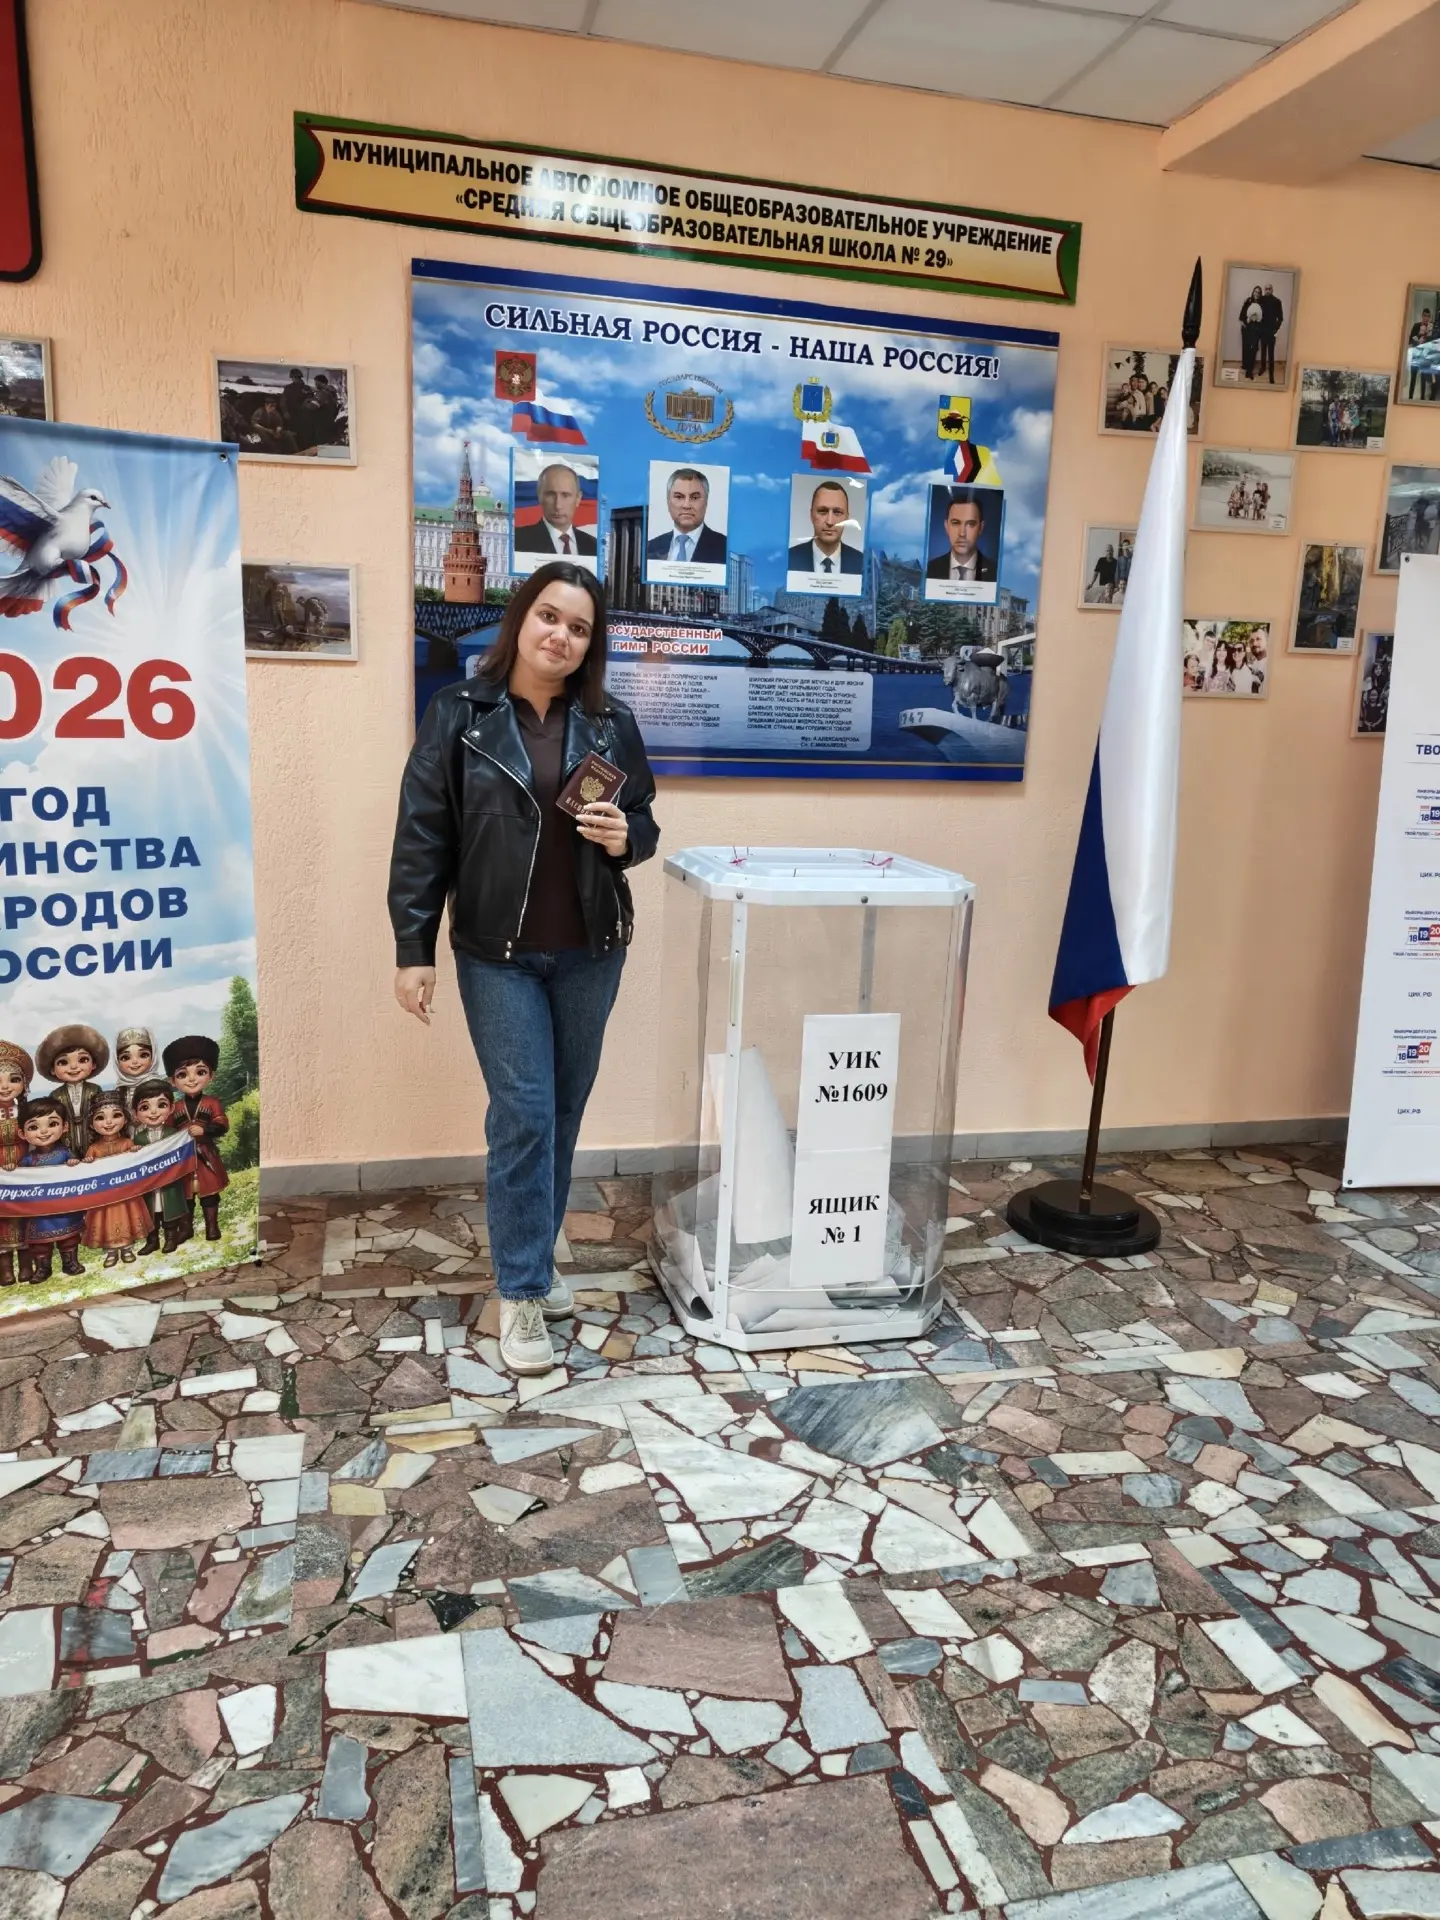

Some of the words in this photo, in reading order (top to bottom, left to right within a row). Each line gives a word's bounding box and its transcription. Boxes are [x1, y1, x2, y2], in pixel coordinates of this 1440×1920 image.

[332, 138, 533, 187] МУНИЦИПАЛЬНОЕ
[540, 167, 681, 207] АВТОНОМНОЕ
[685, 188, 929, 239] ОБЩЕОБРАЗОВАТЕЛЬНОЕ
[932, 221, 1053, 255] УЧРЕЖДЕНИЕ
[456, 187, 565, 222] «СРЕДНЯЯ
[570, 203, 824, 254] ОБЩЕОБРАЗОВАТЕЛЬНАЯ
[829, 238, 896, 264] ШКОЛА
[901, 245, 920, 264] №
[924, 247, 953, 269] 29»
[484, 303, 633, 341] СИЛЬНАЯ
[642, 320, 762, 354] РОССИЯ
[789, 335, 874, 366] НАША
[883, 346, 1000, 379] РОССИЯ!
[606, 624, 722, 640] ОСУДАРСТВЕННЫЙ
[612, 641, 647, 653] ГИМН
[652, 642, 709, 655] РОССИИ
[1415, 744, 1440, 755] ТВО
[0, 786, 110, 827] ГОД
[1420, 814, 1430, 822] 18
[1431, 809, 1440, 818] 19
[0, 887, 188, 931] РОДОВ
[1409, 934, 1418, 942] 18
[1420, 931, 1429, 939] 19
[1430, 926, 1440, 935] 20
[828, 1050, 881, 1070] УИК
[1398, 1052, 1406, 1061] 18
[1409, 1048, 1417, 1057] 19
[1419, 1045, 1429, 1053] 20
[815, 1082, 888, 1103] №1609
[47, 1179, 98, 1197] народов
[109, 1171, 137, 1186] сила
[139, 1151, 182, 1177] России!
[808, 1194, 880, 1215] ЯЩИК
[821, 1226, 845, 1245] №
[852, 1225, 861, 1243] 1
